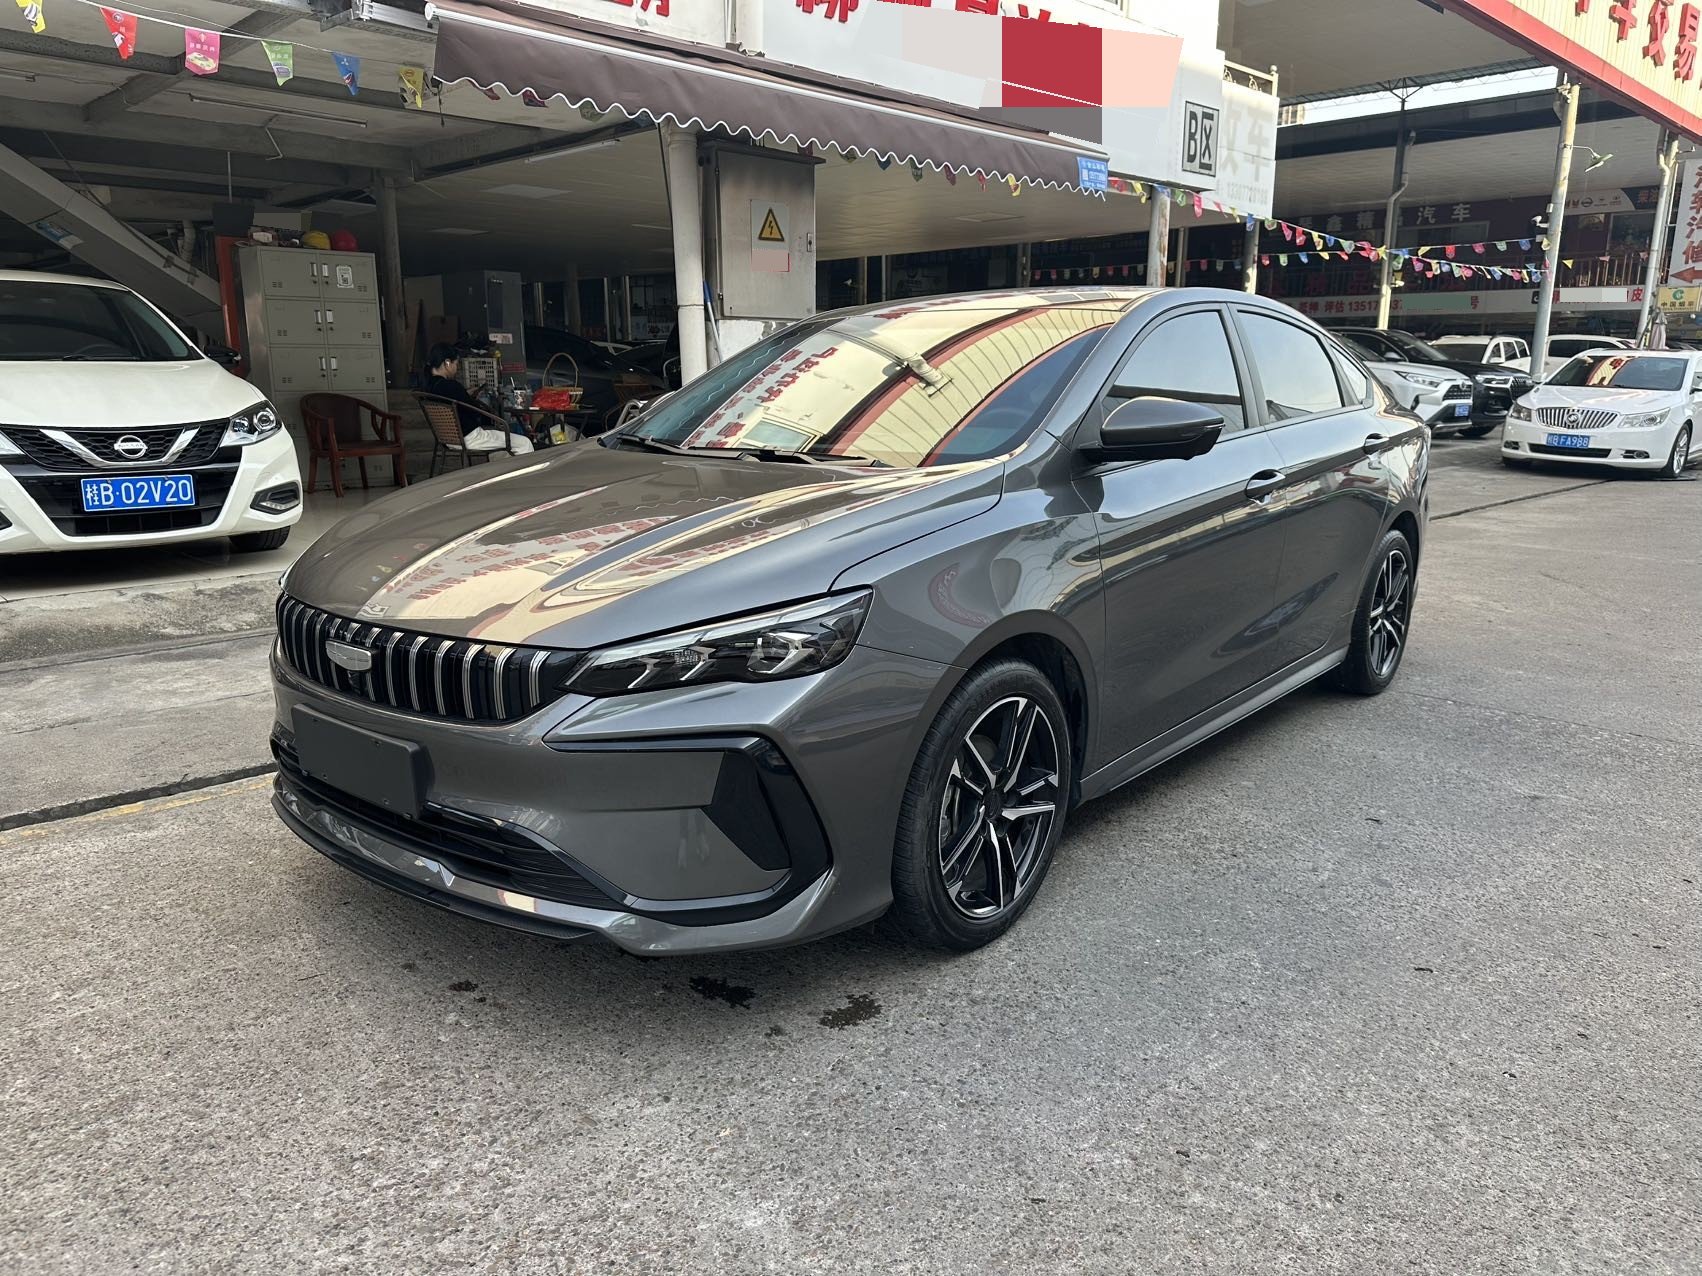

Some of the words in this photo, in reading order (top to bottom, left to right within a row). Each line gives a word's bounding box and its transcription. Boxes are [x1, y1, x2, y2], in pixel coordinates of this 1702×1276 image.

[1575, 0, 1700, 82] 车交易
[1187, 110, 1214, 171] B区
